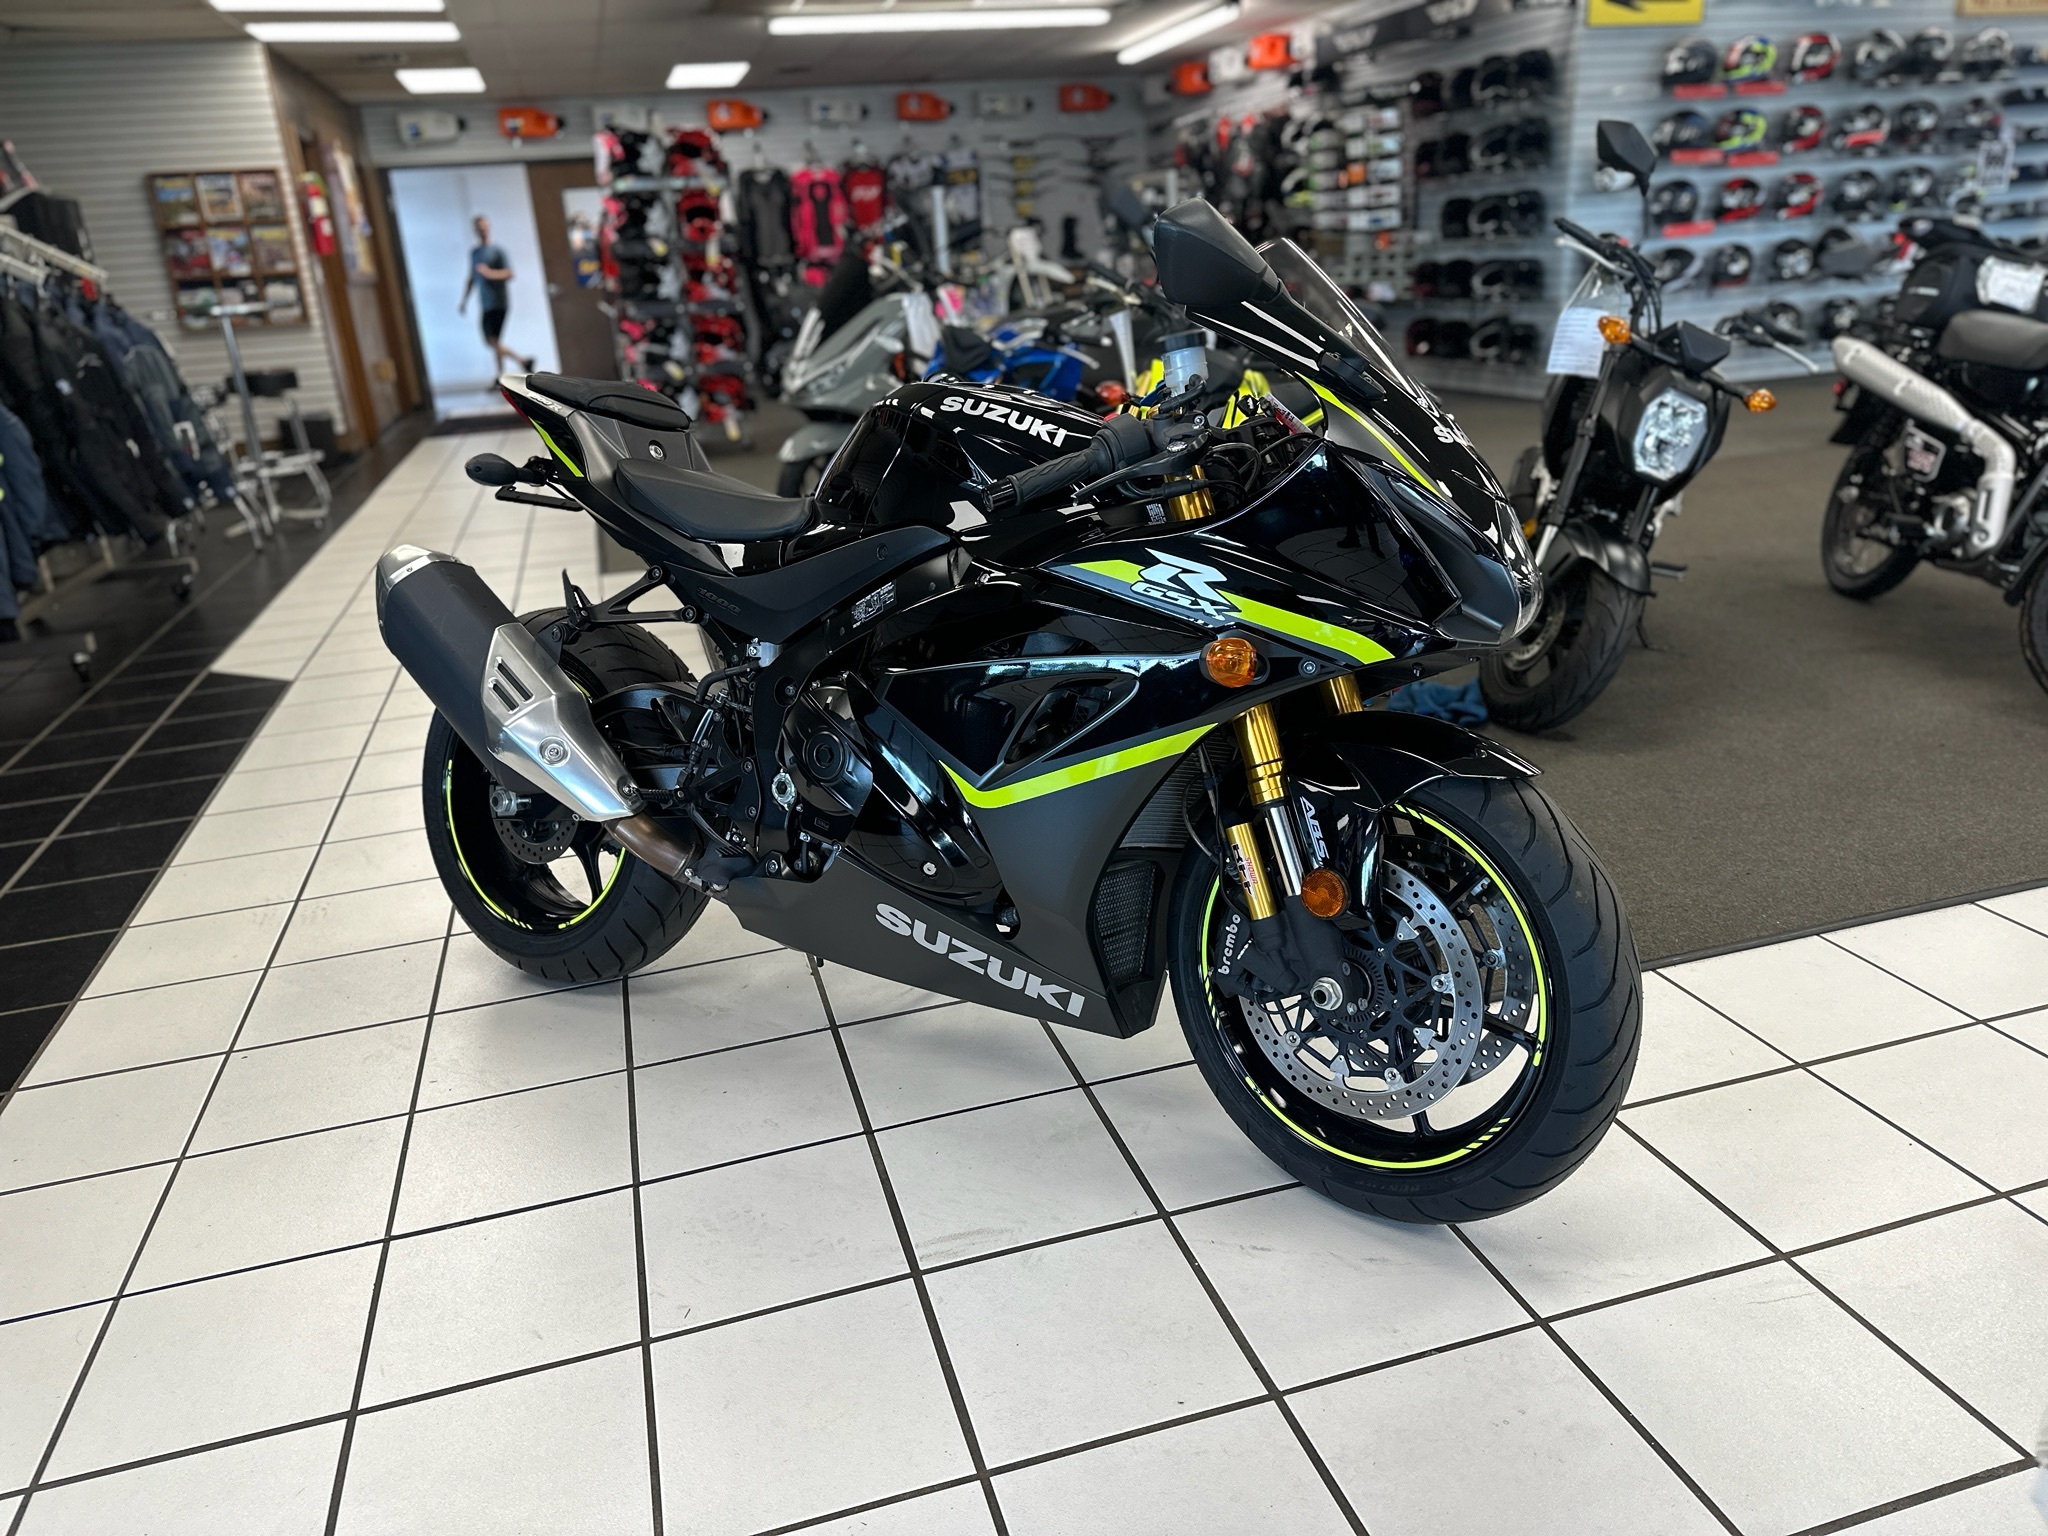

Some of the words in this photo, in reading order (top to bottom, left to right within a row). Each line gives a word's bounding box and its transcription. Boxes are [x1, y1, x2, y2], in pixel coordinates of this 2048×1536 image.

[940, 396, 1067, 448] SUZUKI
[697, 587, 742, 616] 1000
[1130, 580, 1226, 621] GSX
[1141, 546, 1231, 606] R
[1300, 796, 1330, 865] ABS
[1244, 856, 1259, 886] SHOWA
[875, 903, 1086, 1018] SUZUKI
[1217, 914, 1241, 975] brembo
